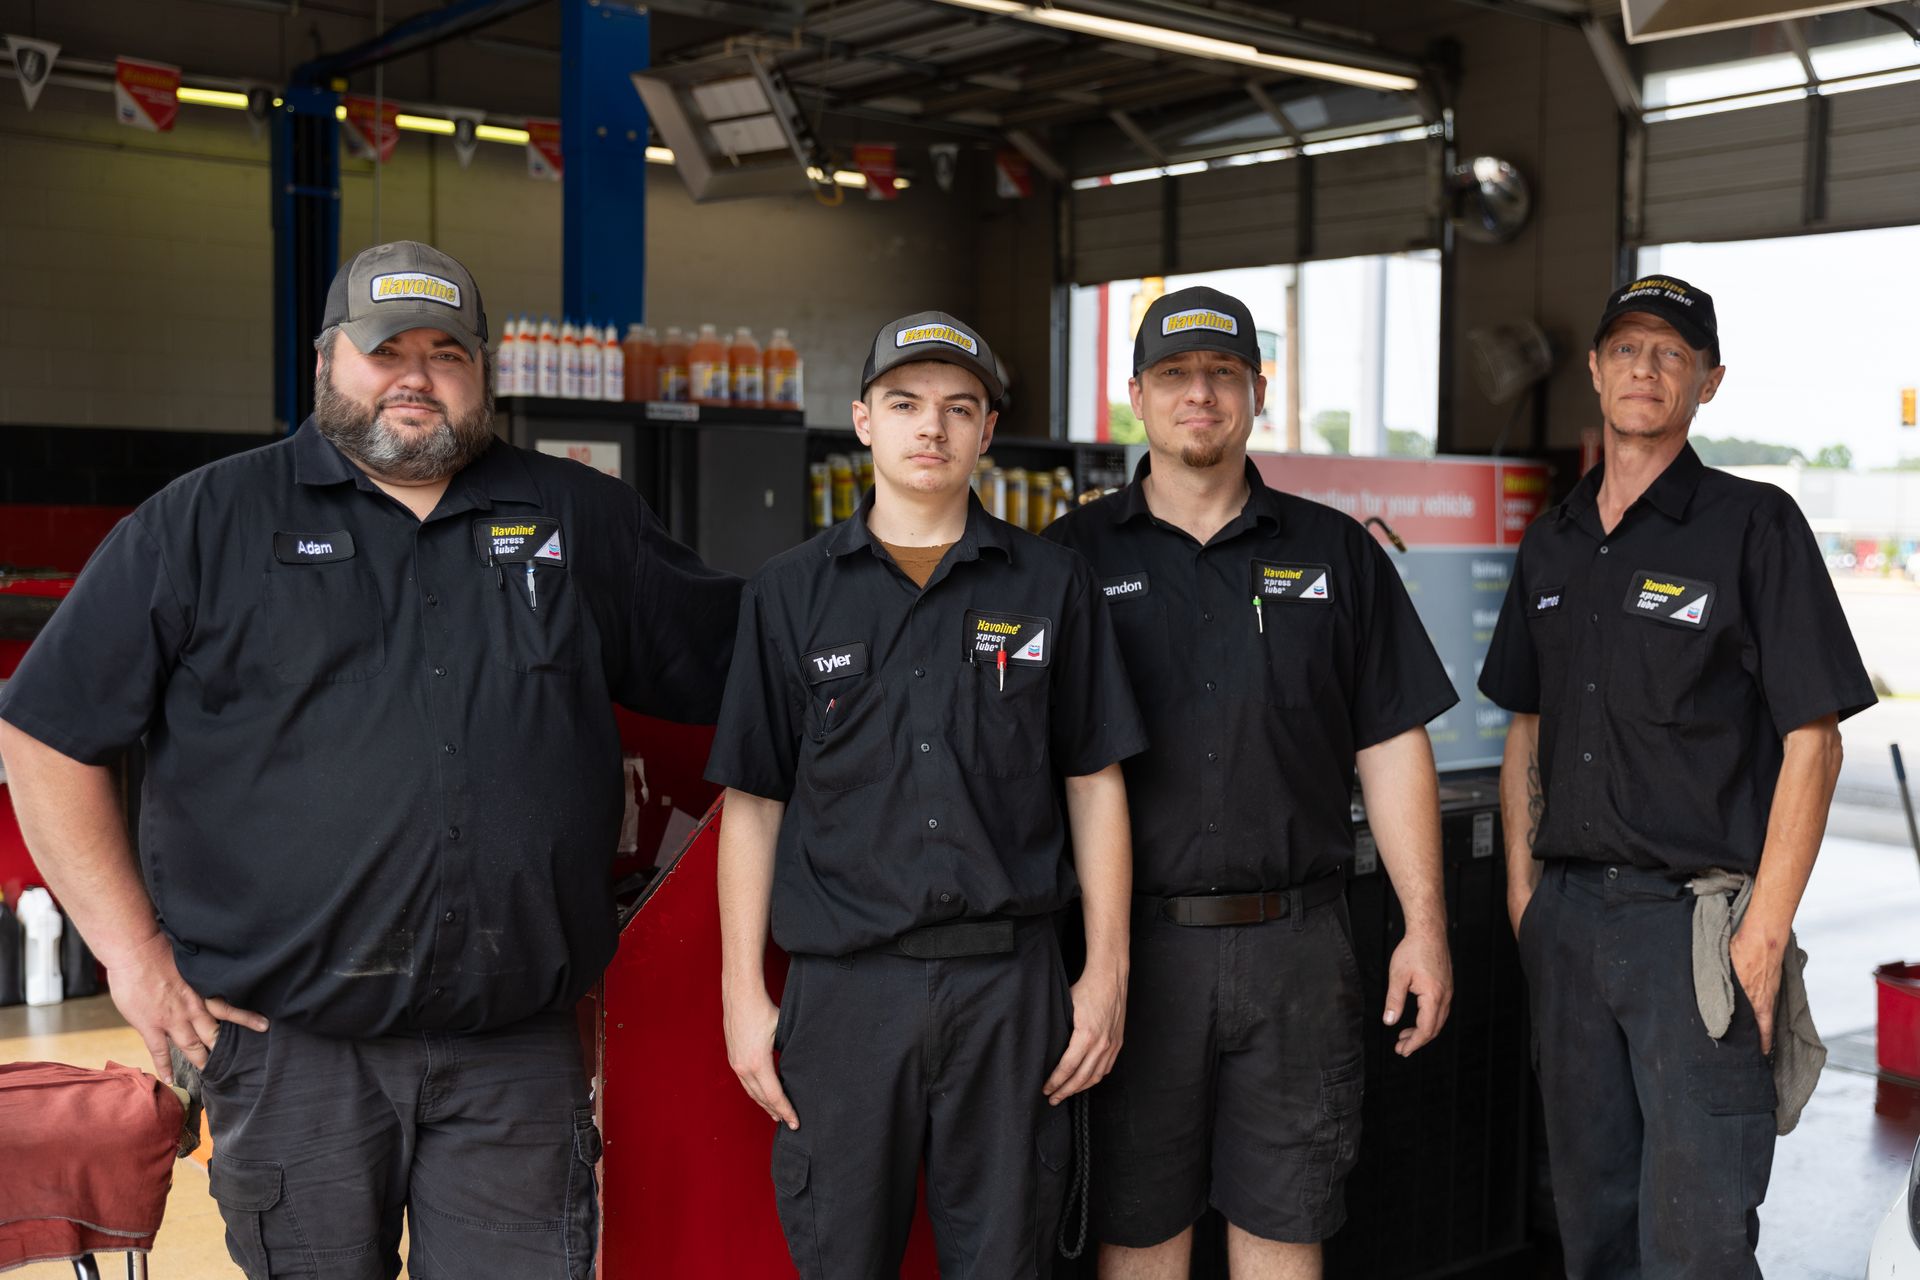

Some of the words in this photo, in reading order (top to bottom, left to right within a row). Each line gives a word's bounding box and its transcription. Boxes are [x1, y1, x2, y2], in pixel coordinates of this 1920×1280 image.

[378, 277, 456, 302] Havoline
[1167, 312, 1233, 332] Havoline
[903, 327, 973, 349] Havoline
[1423, 491, 1475, 517] vehicle
[297, 540, 333, 555] Adam
[493, 537, 525, 546] xpress
[1263, 578, 1292, 587] xpress
[975, 632, 1006, 643] xpress
[813, 653, 851, 673] Tyler
